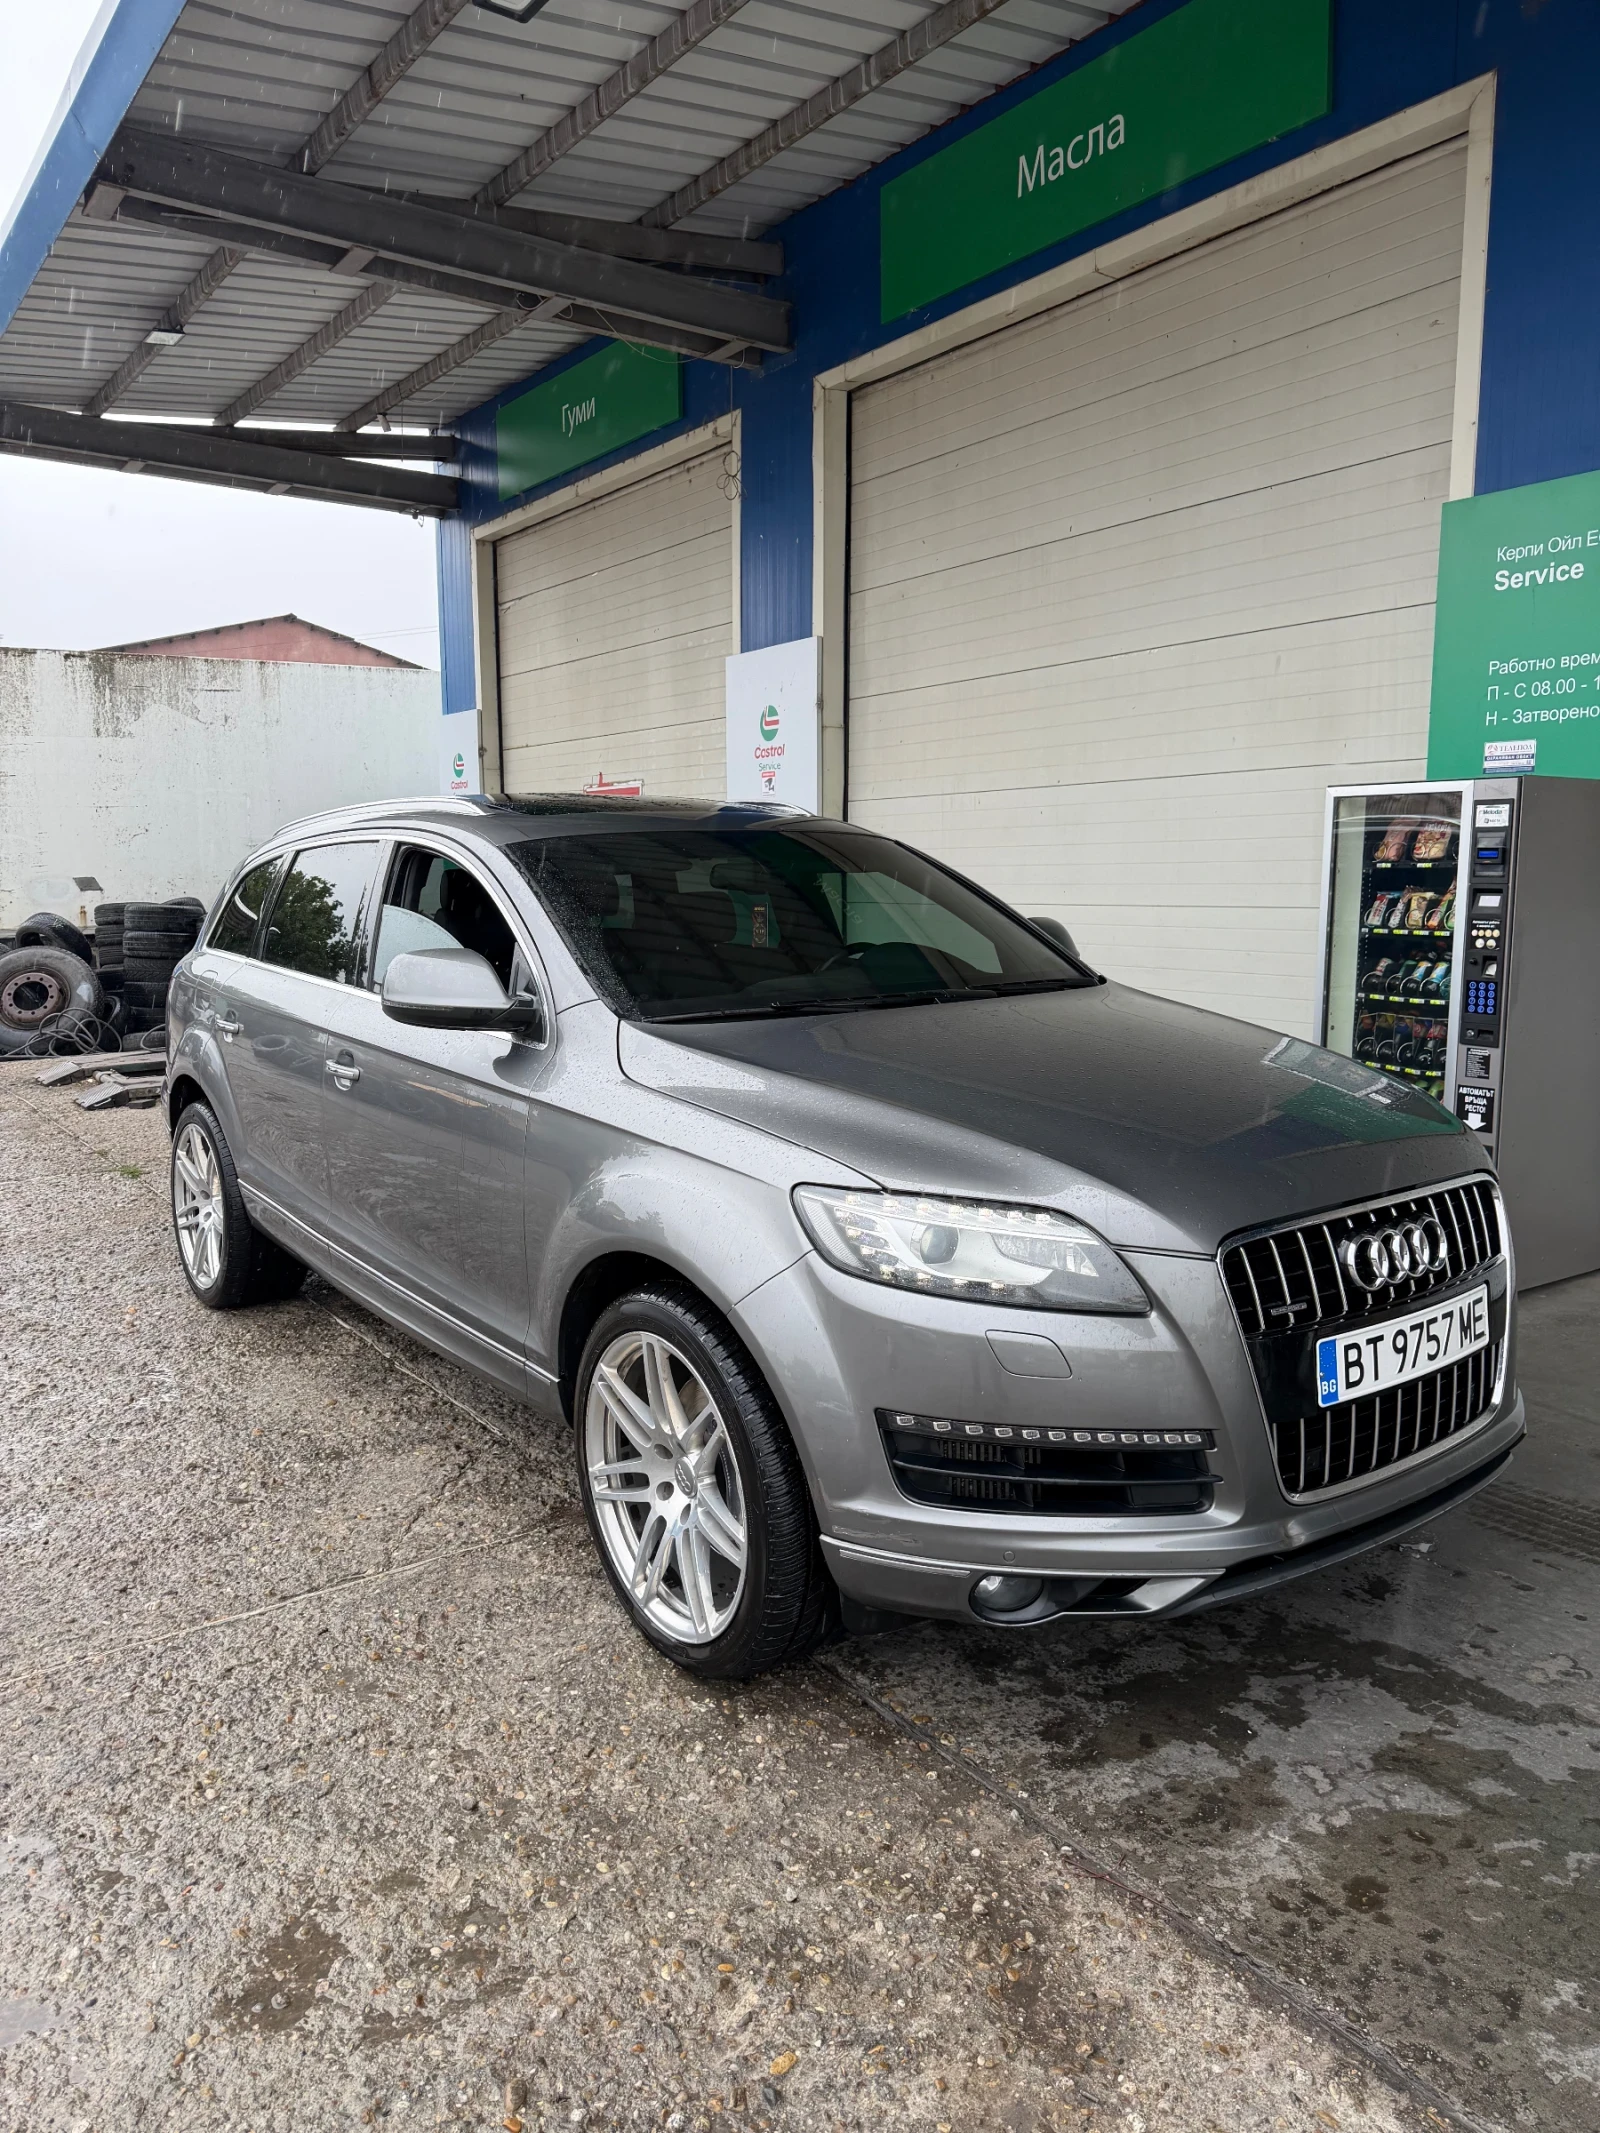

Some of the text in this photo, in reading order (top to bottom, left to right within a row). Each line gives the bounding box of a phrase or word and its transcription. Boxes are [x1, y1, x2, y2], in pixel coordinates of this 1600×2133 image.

[1017, 113, 1125, 198] Масла
[562, 397, 595, 438] Гуми
[1497, 529, 1600, 563] Керпи Ойл Е
[1494, 561, 1585, 591] Service
[1489, 657, 1556, 676] Работно
[1487, 685, 1499, 701] П
[1514, 682, 1527, 698] С
[1531, 677, 1576, 697] 08.00
[1485, 710, 1498, 726] Н
[1512, 705, 1600, 724] Затворено
[754, 743, 786, 760] Castrol
[758, 761, 781, 772] Service
[450, 780, 469, 790] Castrol
[1458, 1086, 1495, 1098] АВТОМАТЪТ
[1343, 1297, 1487, 1390] BT 9757 ME
[1321, 1379, 1337, 1396] BG
